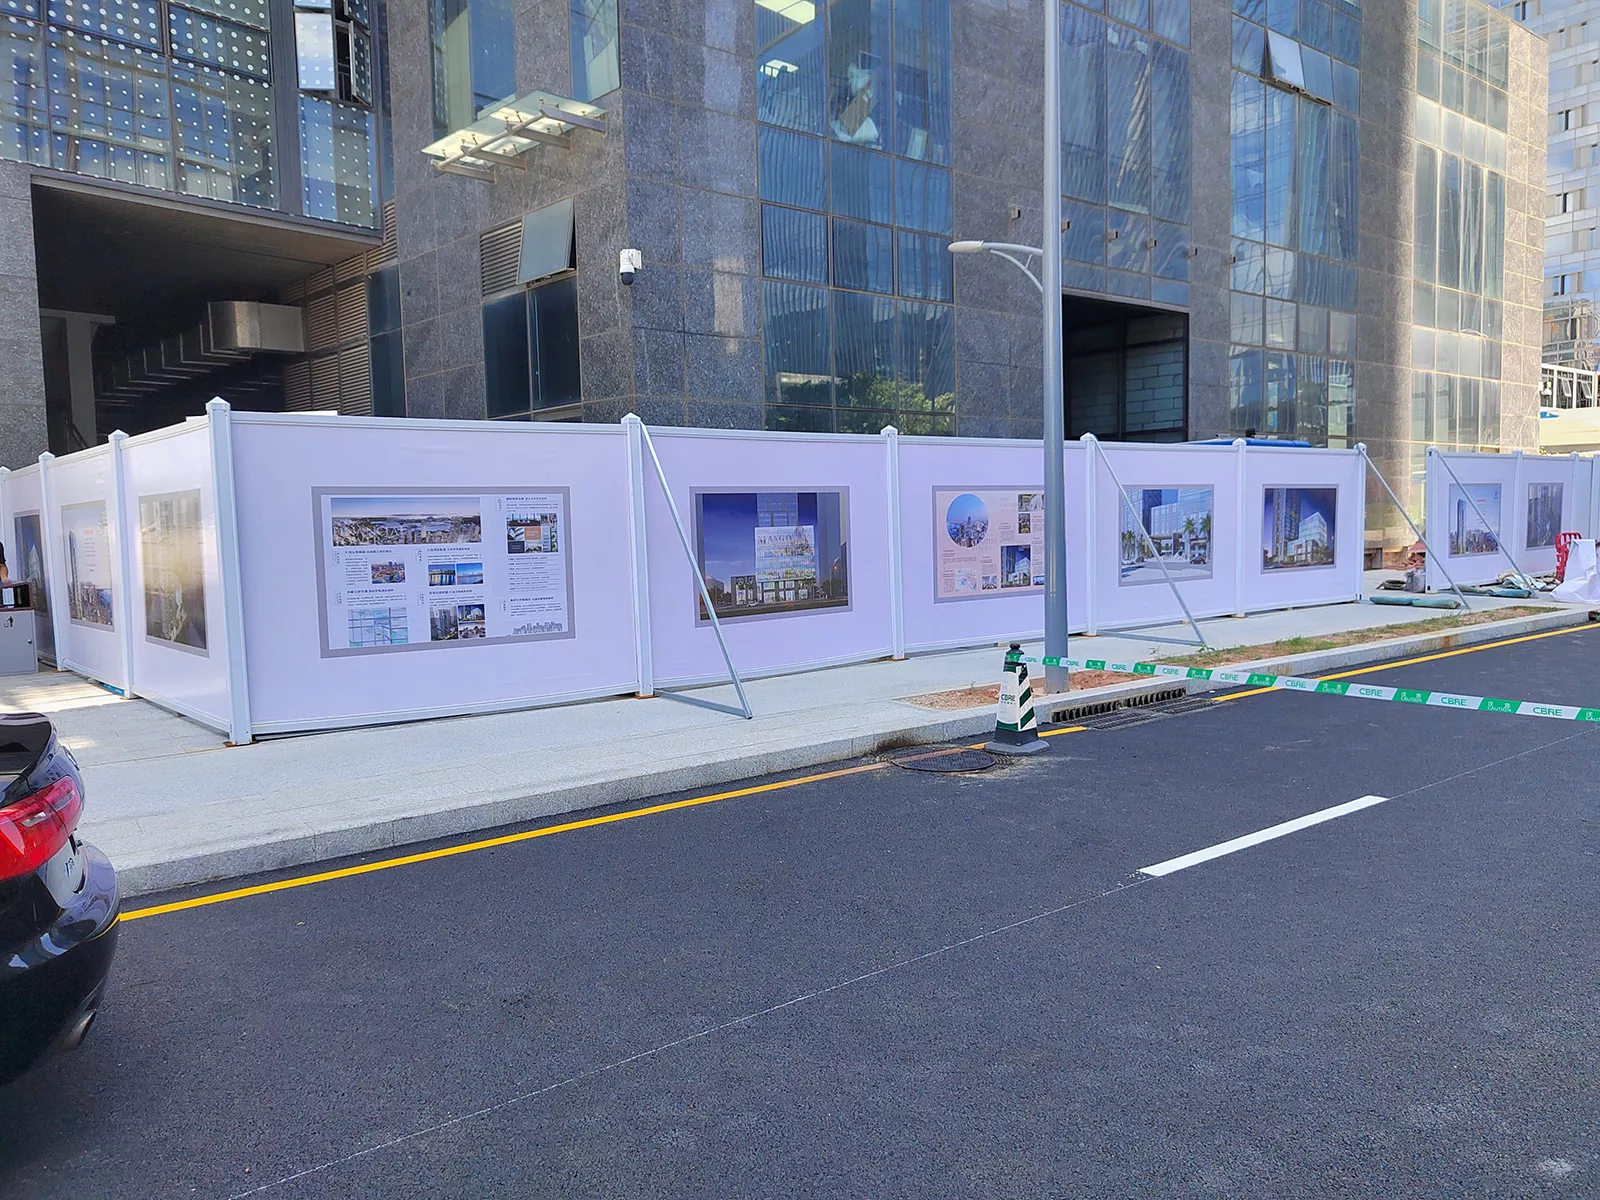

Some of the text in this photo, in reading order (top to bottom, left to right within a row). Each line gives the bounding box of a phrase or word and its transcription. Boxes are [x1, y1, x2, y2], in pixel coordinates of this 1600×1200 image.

[1162, 667, 1179, 675] CBRE
[1220, 672, 1239, 681] CBRE
[1285, 679, 1306, 688] CBRE
[1359, 687, 1383, 697] CBRE
[1000, 693, 1016, 702] CBRE
[1441, 696, 1467, 706] CBRE
[1487, 705, 1511, 713] CAUTION
[1532, 706, 1562, 716] CBRE
